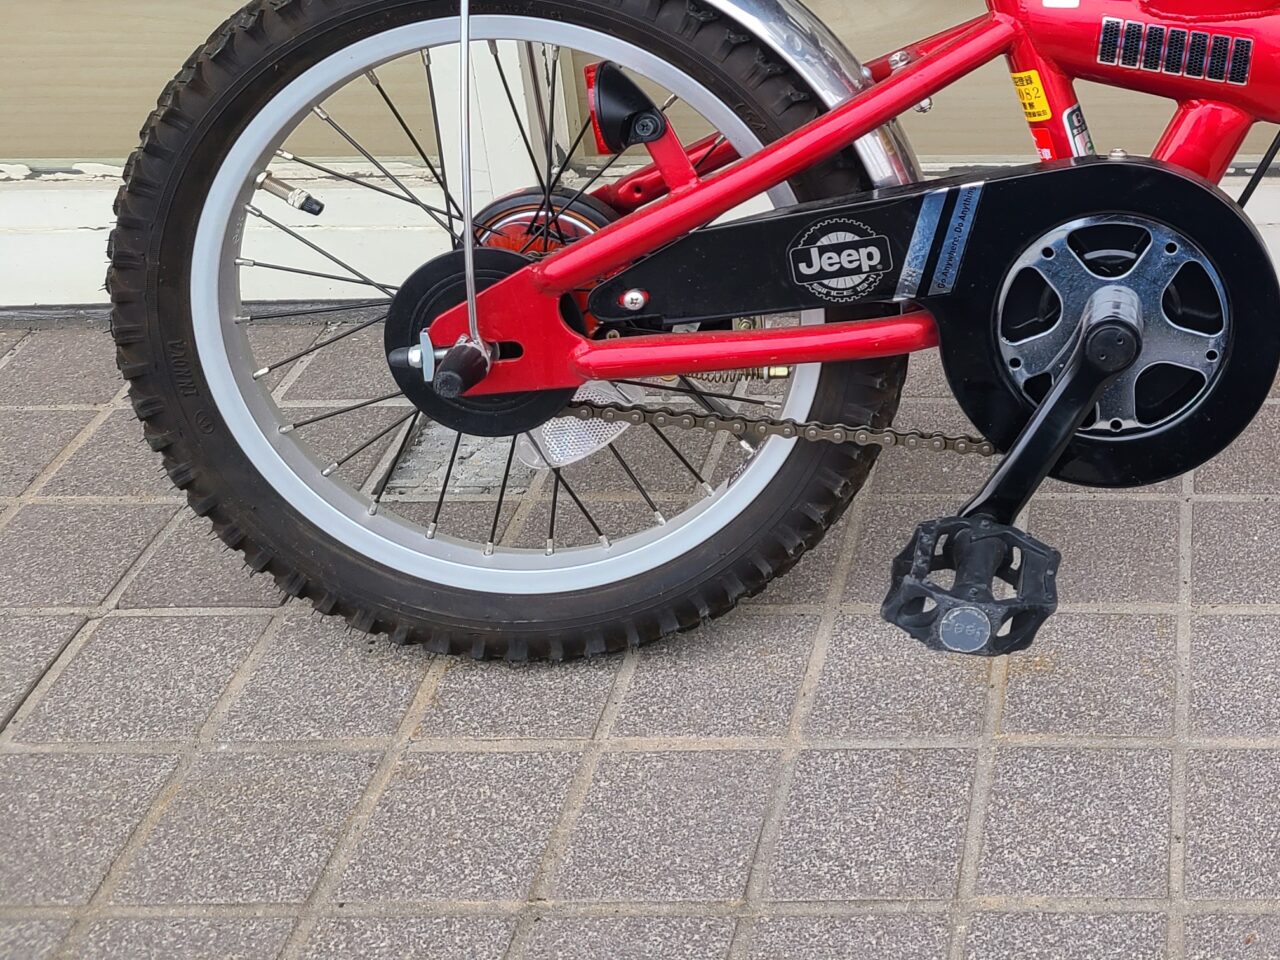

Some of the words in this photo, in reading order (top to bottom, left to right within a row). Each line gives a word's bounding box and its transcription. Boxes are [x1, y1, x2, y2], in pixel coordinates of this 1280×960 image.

[799, 246, 881, 274] Jeep
[938, 280, 946, 289] Go
[954, 222, 964, 233] Do
[811, 283, 854, 296] SINCE
[856, 275, 876, 291] 1941
